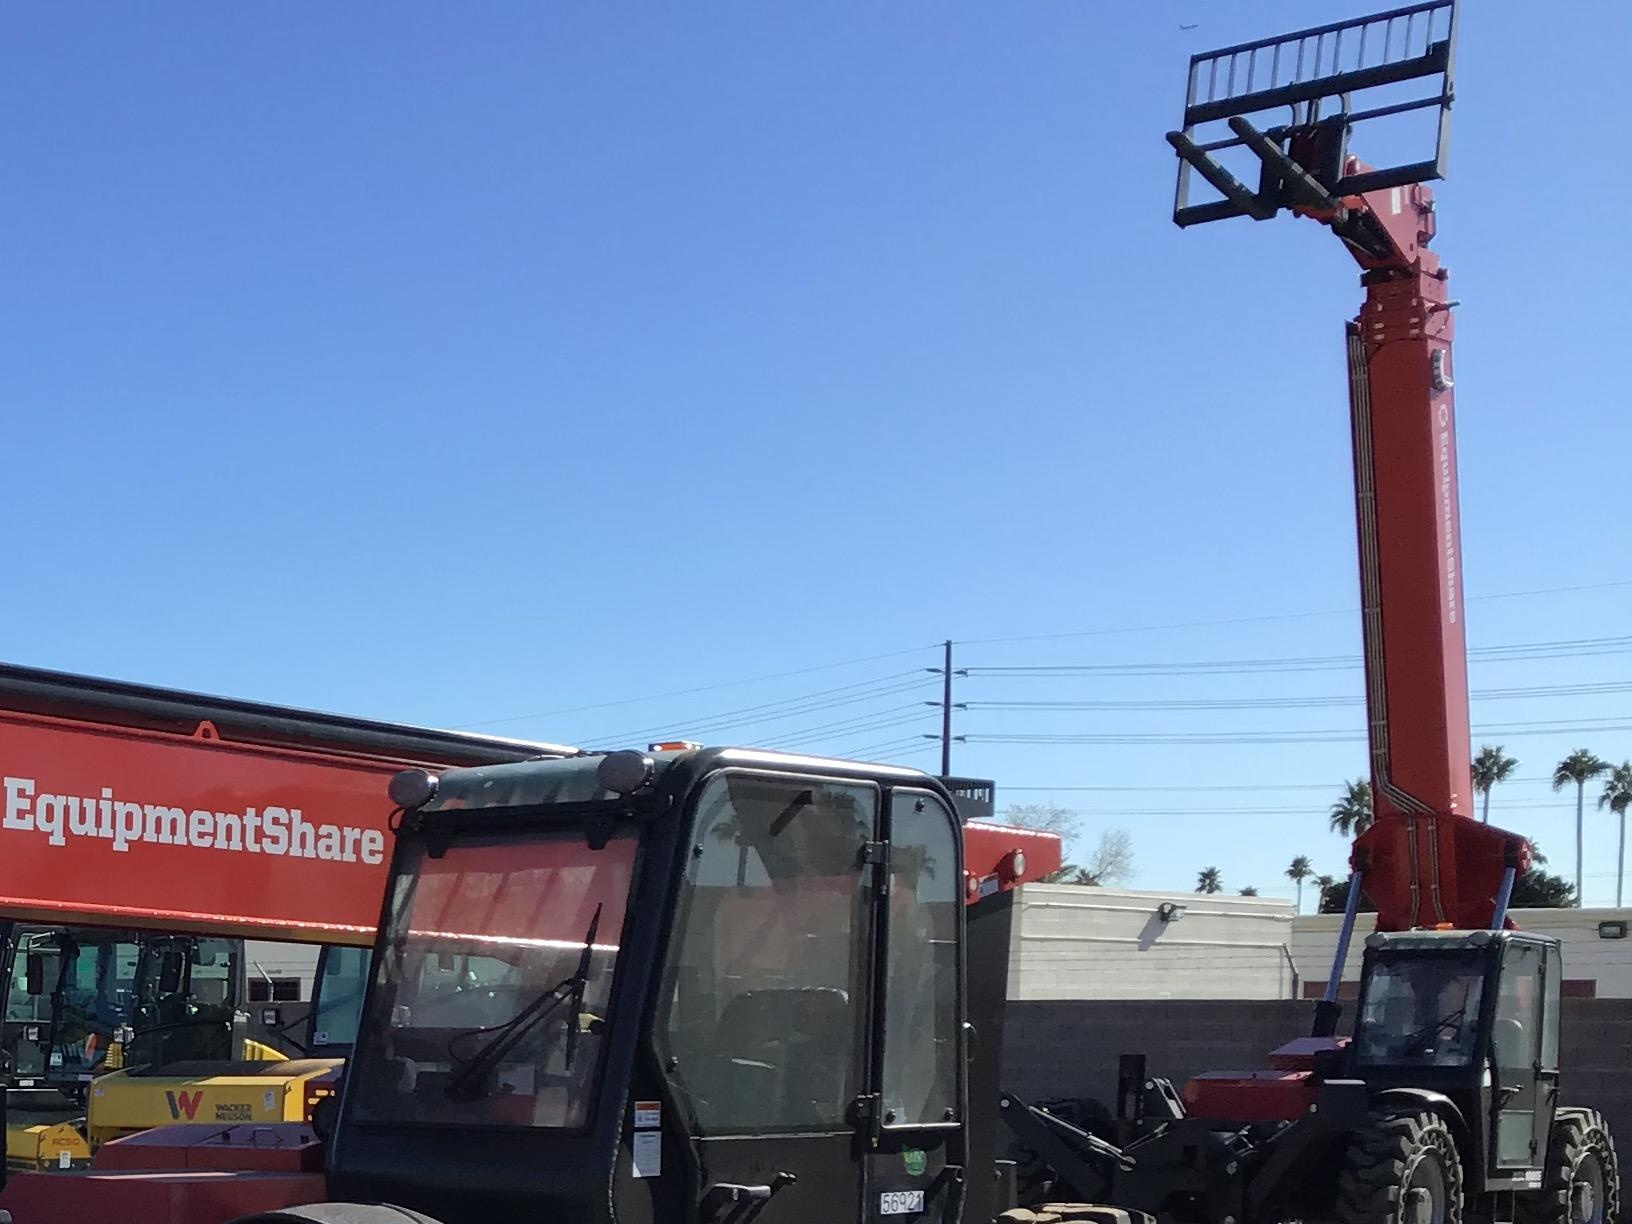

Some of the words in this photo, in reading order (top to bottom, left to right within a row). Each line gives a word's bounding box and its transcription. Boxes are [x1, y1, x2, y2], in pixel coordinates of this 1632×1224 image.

[2, 776, 384, 865] EquipmentShare
[216, 1104, 252, 1112] WACKER
[216, 1112, 252, 1121] NEUSON
[882, 1192, 922, 1213] 56921
